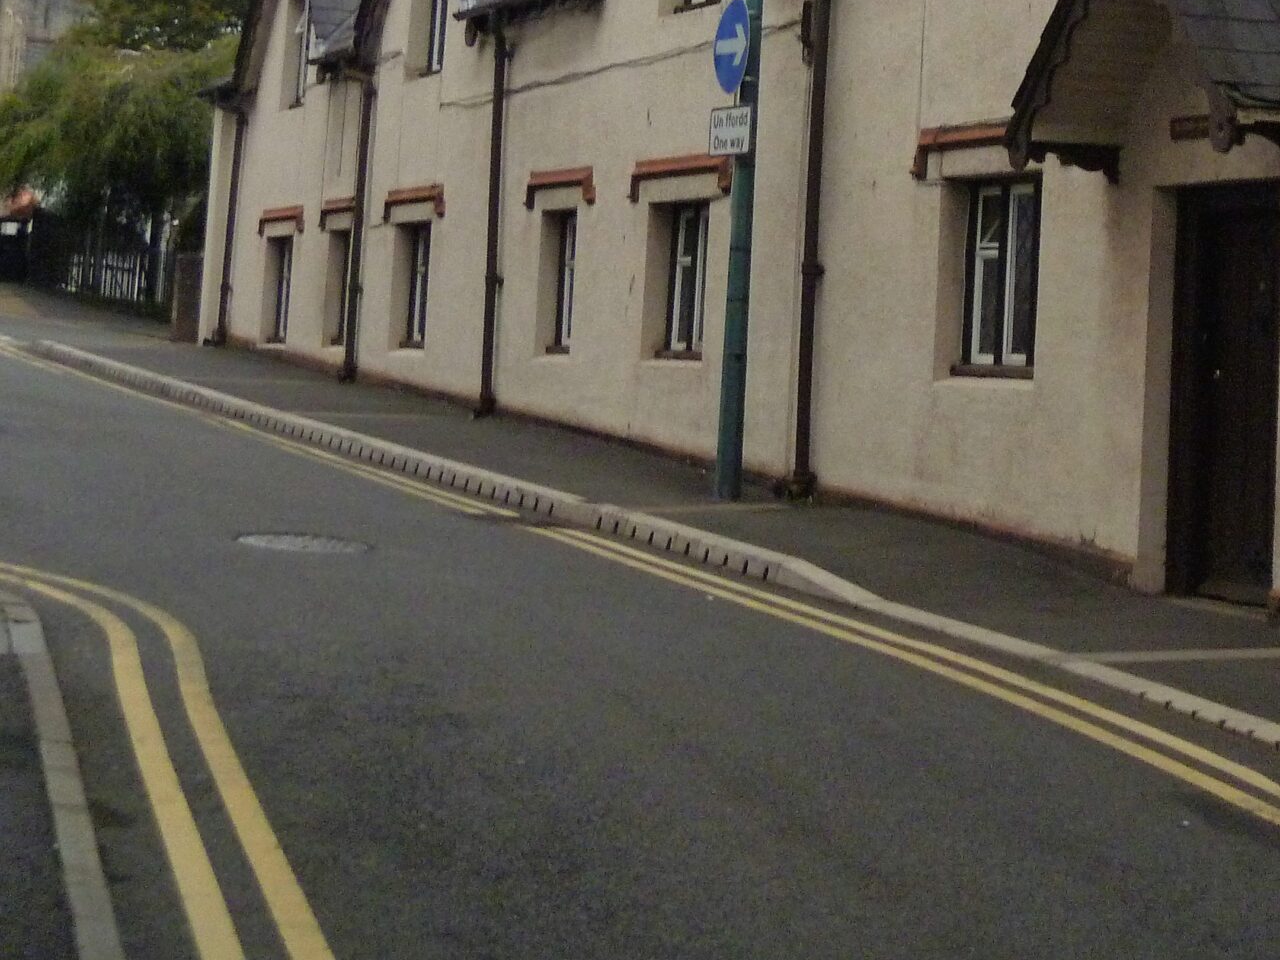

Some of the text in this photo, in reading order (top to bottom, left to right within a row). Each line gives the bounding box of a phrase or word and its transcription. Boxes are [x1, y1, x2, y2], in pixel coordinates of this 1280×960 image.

[713, 114, 723, 129] Un
[713, 135, 745, 151] One way
